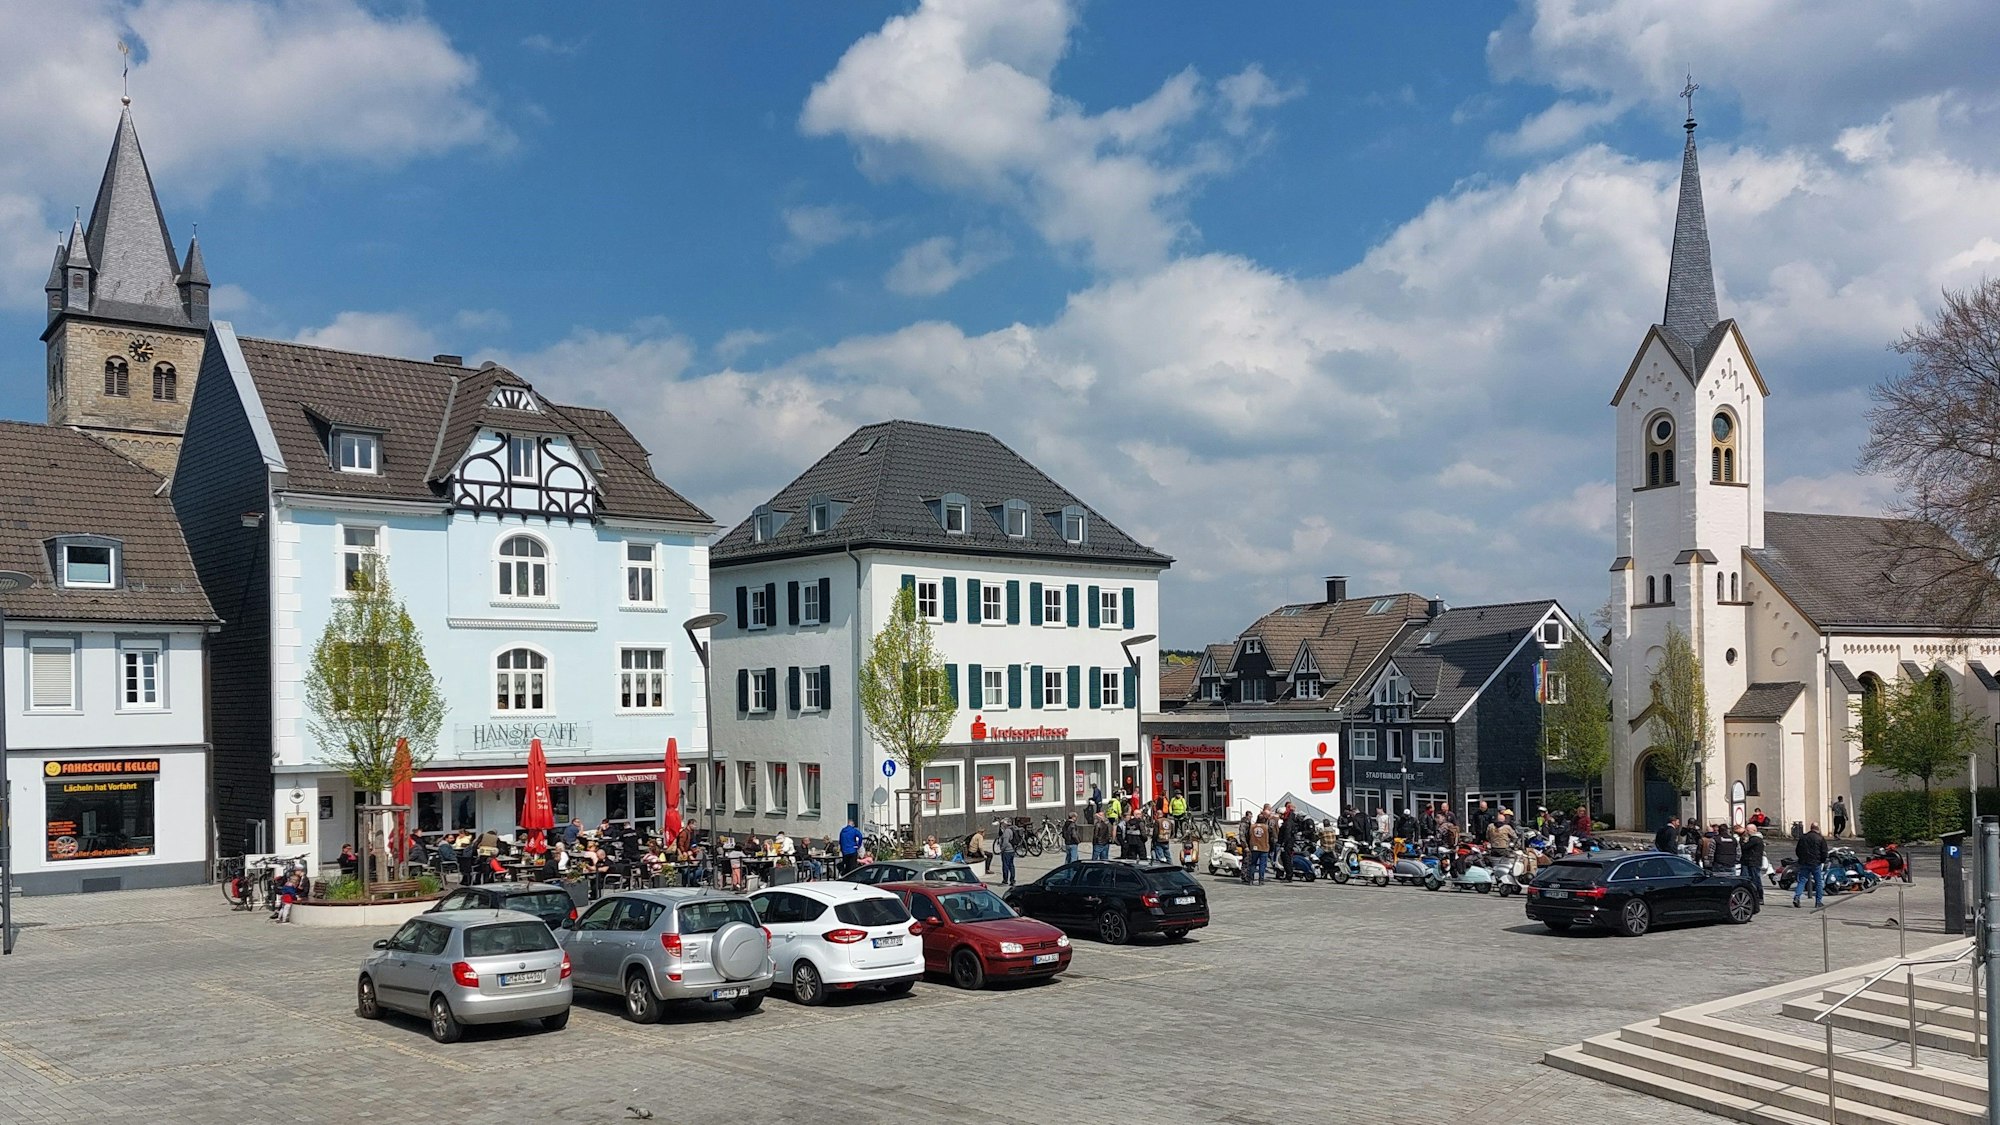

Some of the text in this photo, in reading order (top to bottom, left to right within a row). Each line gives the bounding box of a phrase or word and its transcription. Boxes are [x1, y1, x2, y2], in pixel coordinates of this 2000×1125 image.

[991, 726, 1068, 740] Kreissparkasse
[1165, 744, 1223, 753] Kreissparkasse
[62, 761, 158, 774] FAHRSCHULE KELLER
[1366, 771, 1415, 781] STADTBIBLIOEK
[64, 782, 138, 793] Lächeln hat Vorfahrt
[437, 781, 484, 791] WARSTEINER
[616, 774, 658, 783] WARSTEINER
[1949, 846, 1958, 856] P
